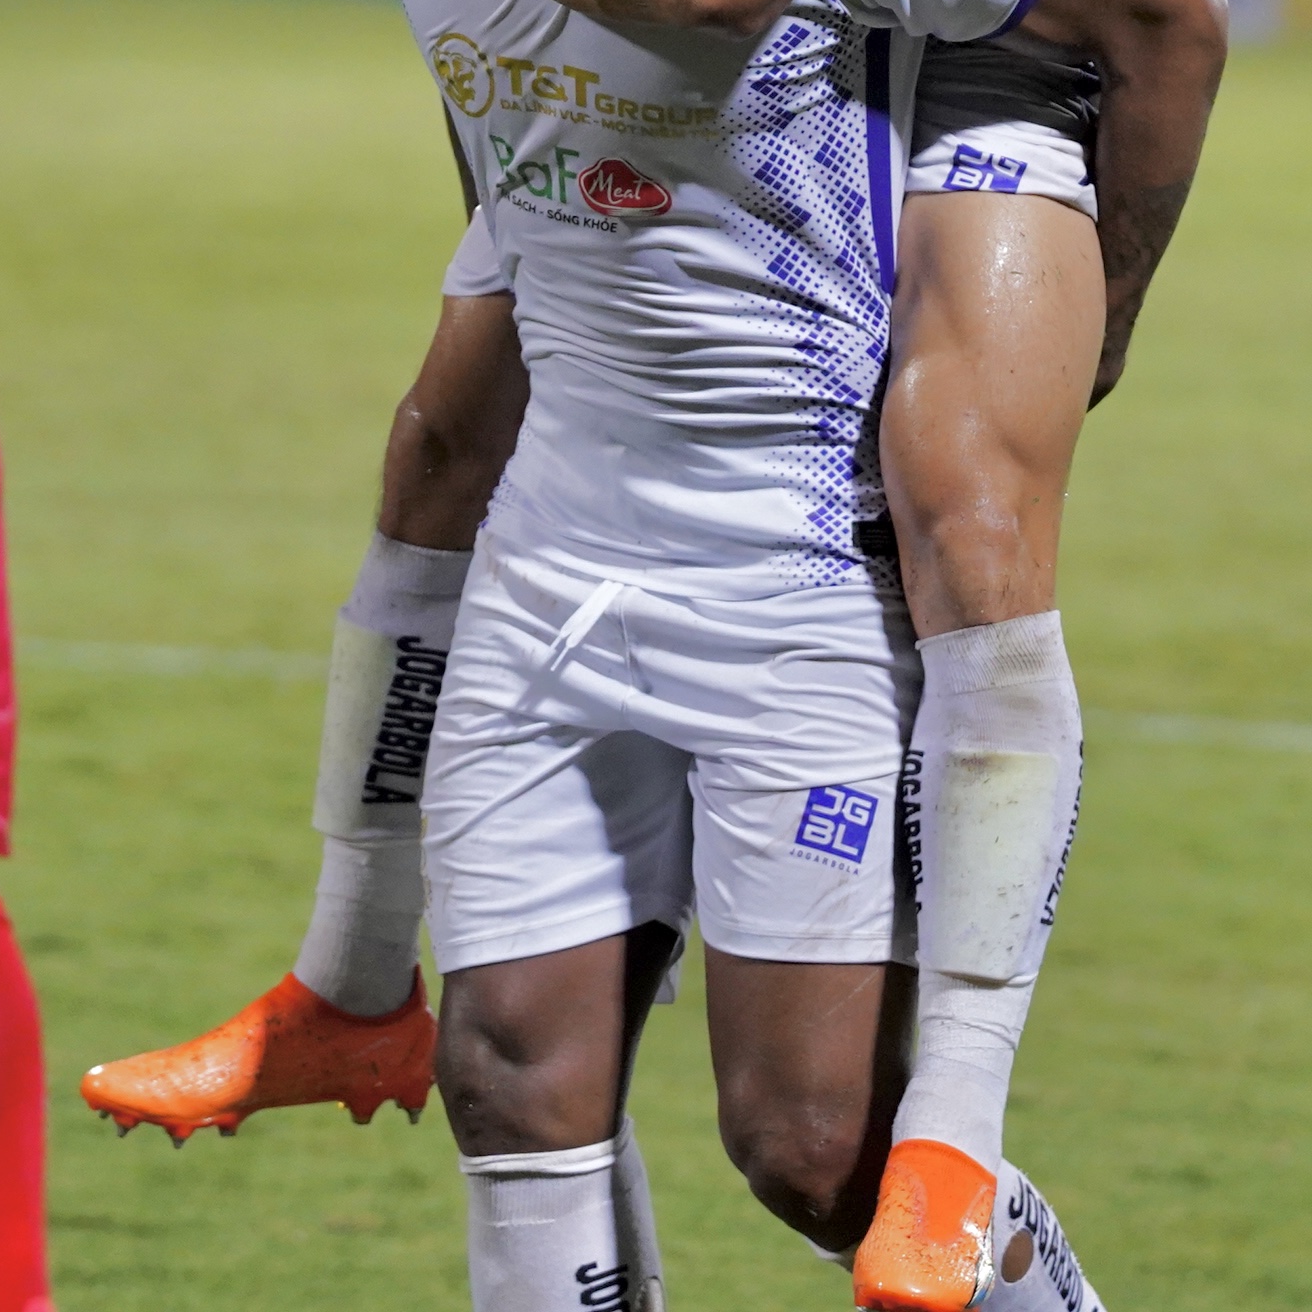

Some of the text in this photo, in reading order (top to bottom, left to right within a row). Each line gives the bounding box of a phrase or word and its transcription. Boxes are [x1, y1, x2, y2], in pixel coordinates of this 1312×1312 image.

[496, 55, 720, 127] T&T GROUP
[588, 168, 643, 205] Meat
[546, 207, 580, 226] SỐNG
[582, 216, 618, 234] KHỎE
[361, 635, 450, 804] JOGARBOLA
[811, 786, 874, 828] JG
[801, 813, 860, 857] BL
[789, 848, 859, 876] JOGARBOLA
[575, 1261, 632, 1312] JO
